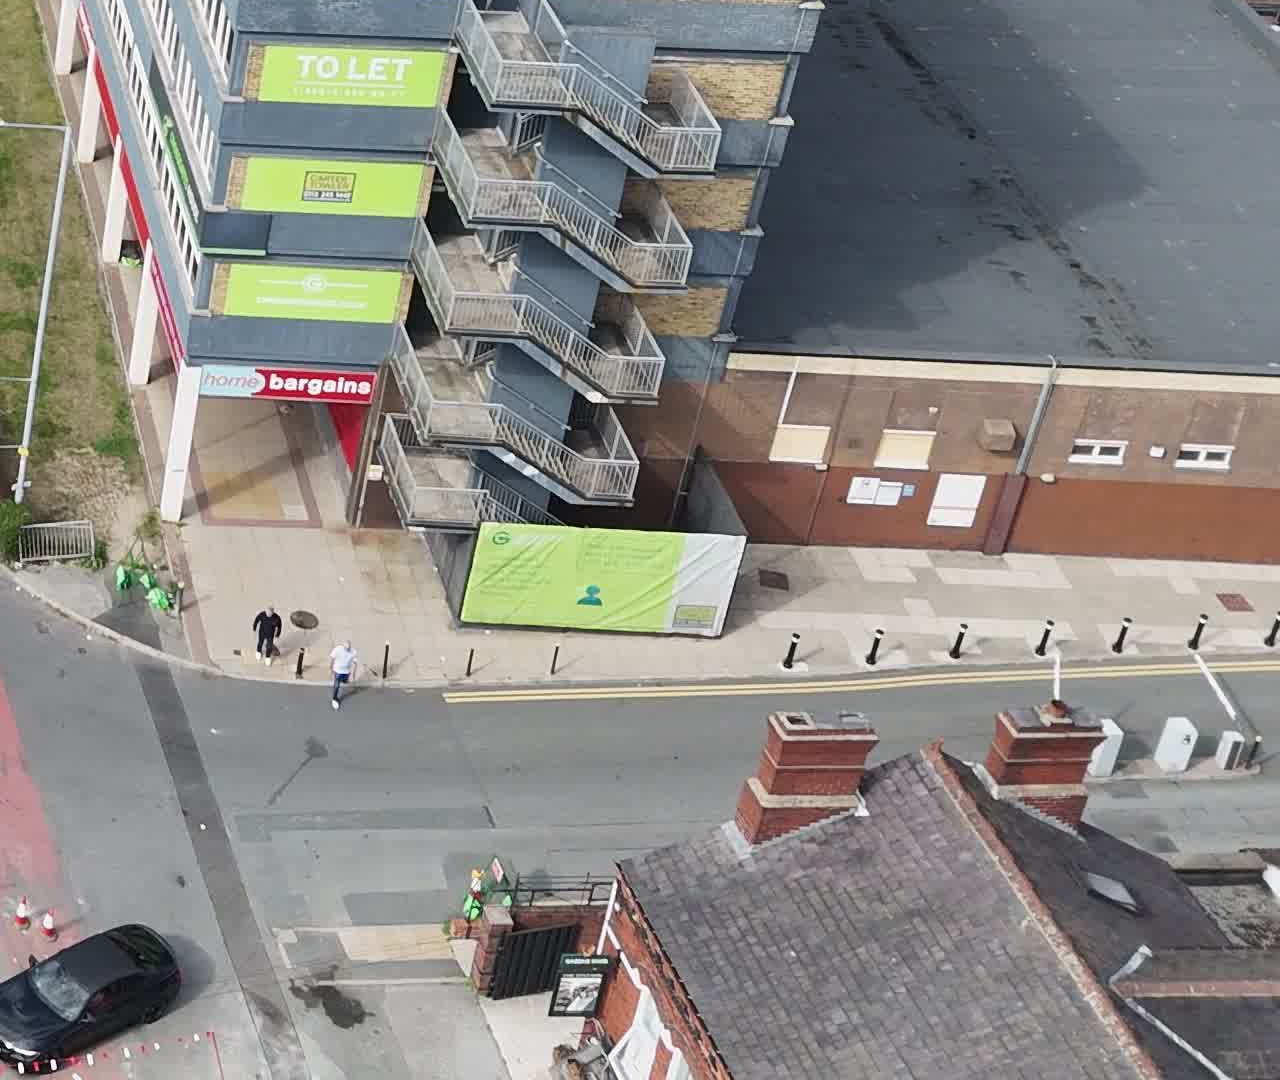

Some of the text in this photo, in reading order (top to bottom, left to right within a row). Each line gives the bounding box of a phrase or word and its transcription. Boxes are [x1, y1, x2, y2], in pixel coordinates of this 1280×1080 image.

[297, 55, 413, 81] TO LET
[203, 371, 371, 396] home bargains
